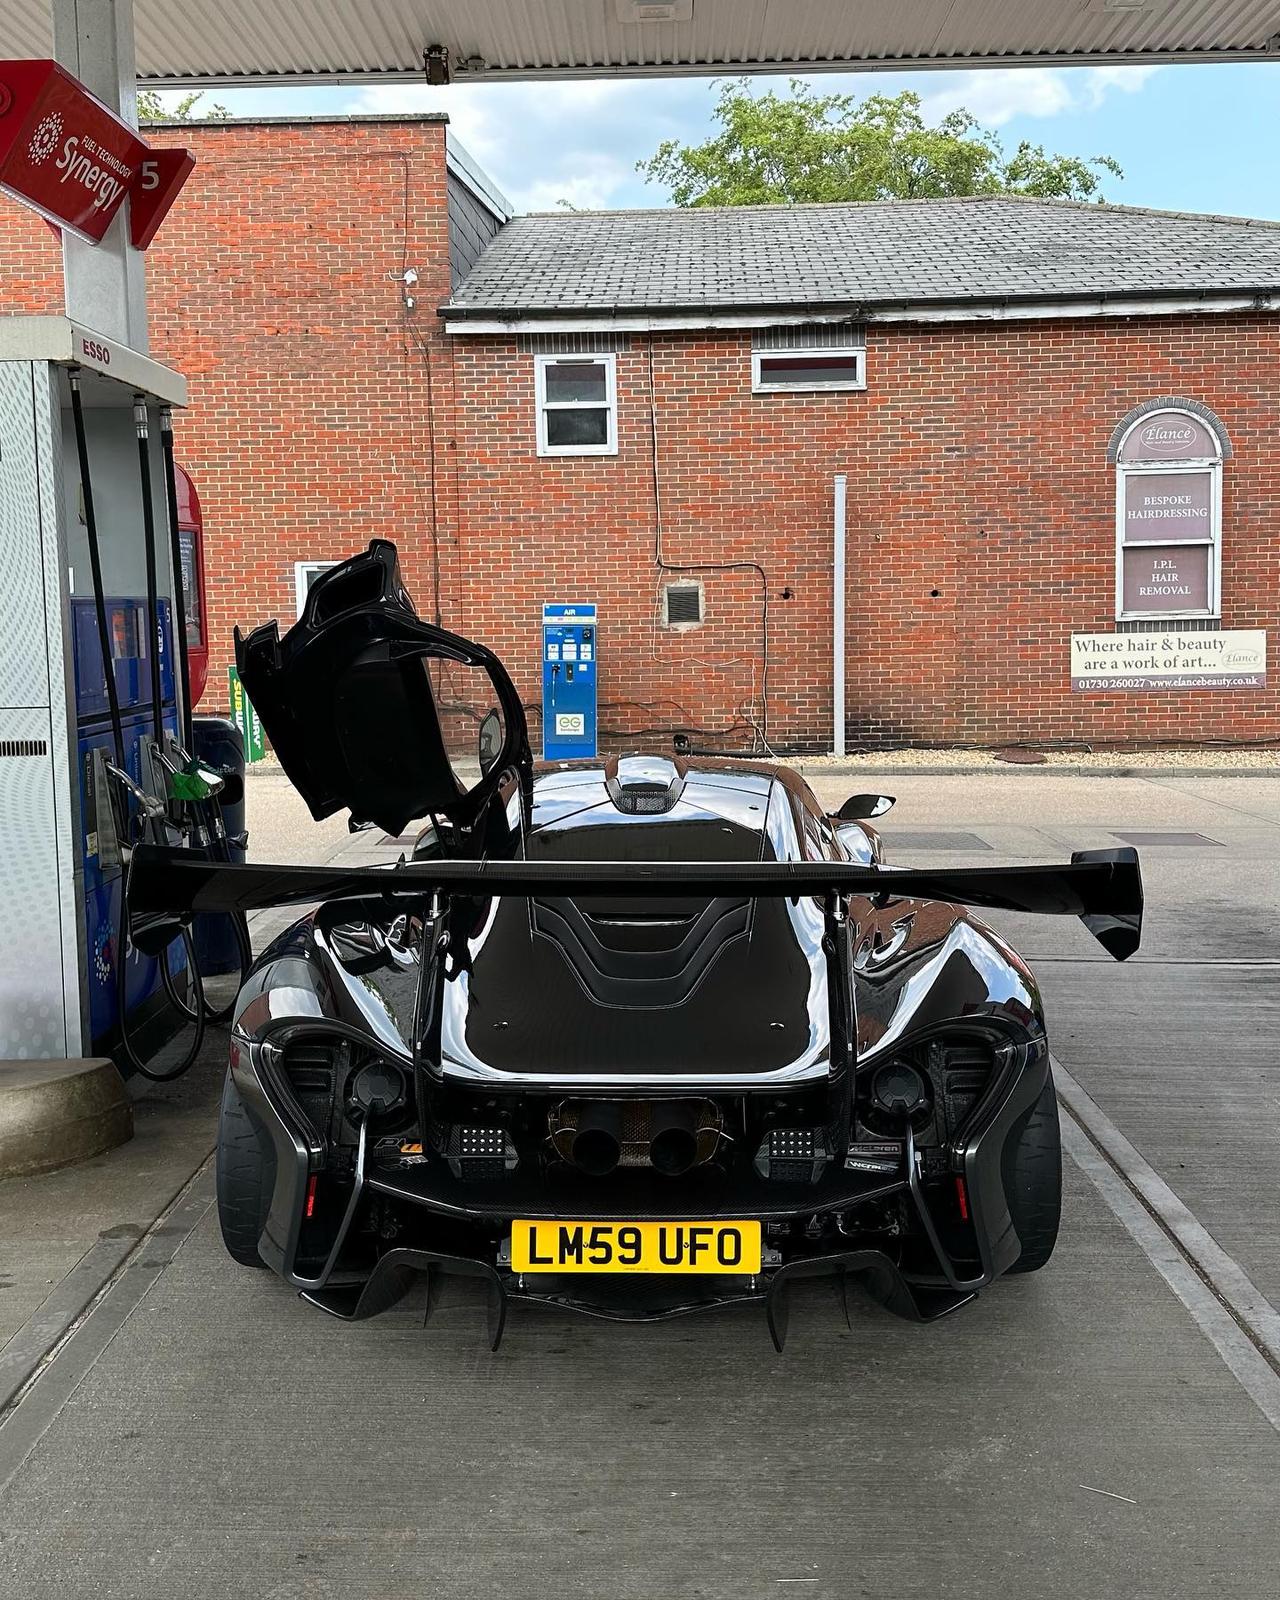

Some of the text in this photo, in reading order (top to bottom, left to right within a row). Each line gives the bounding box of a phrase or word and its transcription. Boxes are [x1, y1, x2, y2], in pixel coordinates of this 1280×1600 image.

[81, 135, 133, 179] FUEL TECHNOLOGY
[55, 136, 124, 212] Synergy
[141, 161, 159, 190] 5
[82, 338, 110, 365] ESSO
[1144, 495, 1192, 506] BESPOKE
[1128, 507, 1208, 519] HAIRDRESSING
[1153, 560, 1176, 569] I.P.L.
[1152, 573, 1179, 582] HAIR
[1139, 585, 1191, 596] REMOVAL
[563, 608, 576, 616] AIR
[1075, 637, 1227, 654] Where hair & beauty
[1084, 655, 1217, 670] are a work of art...
[1078, 676, 1258, 689] 01730 260027 www.elancebeauty.co.uk
[233, 678, 244, 736] SUBW
[528, 1226, 742, 1266] LM59 UFO
